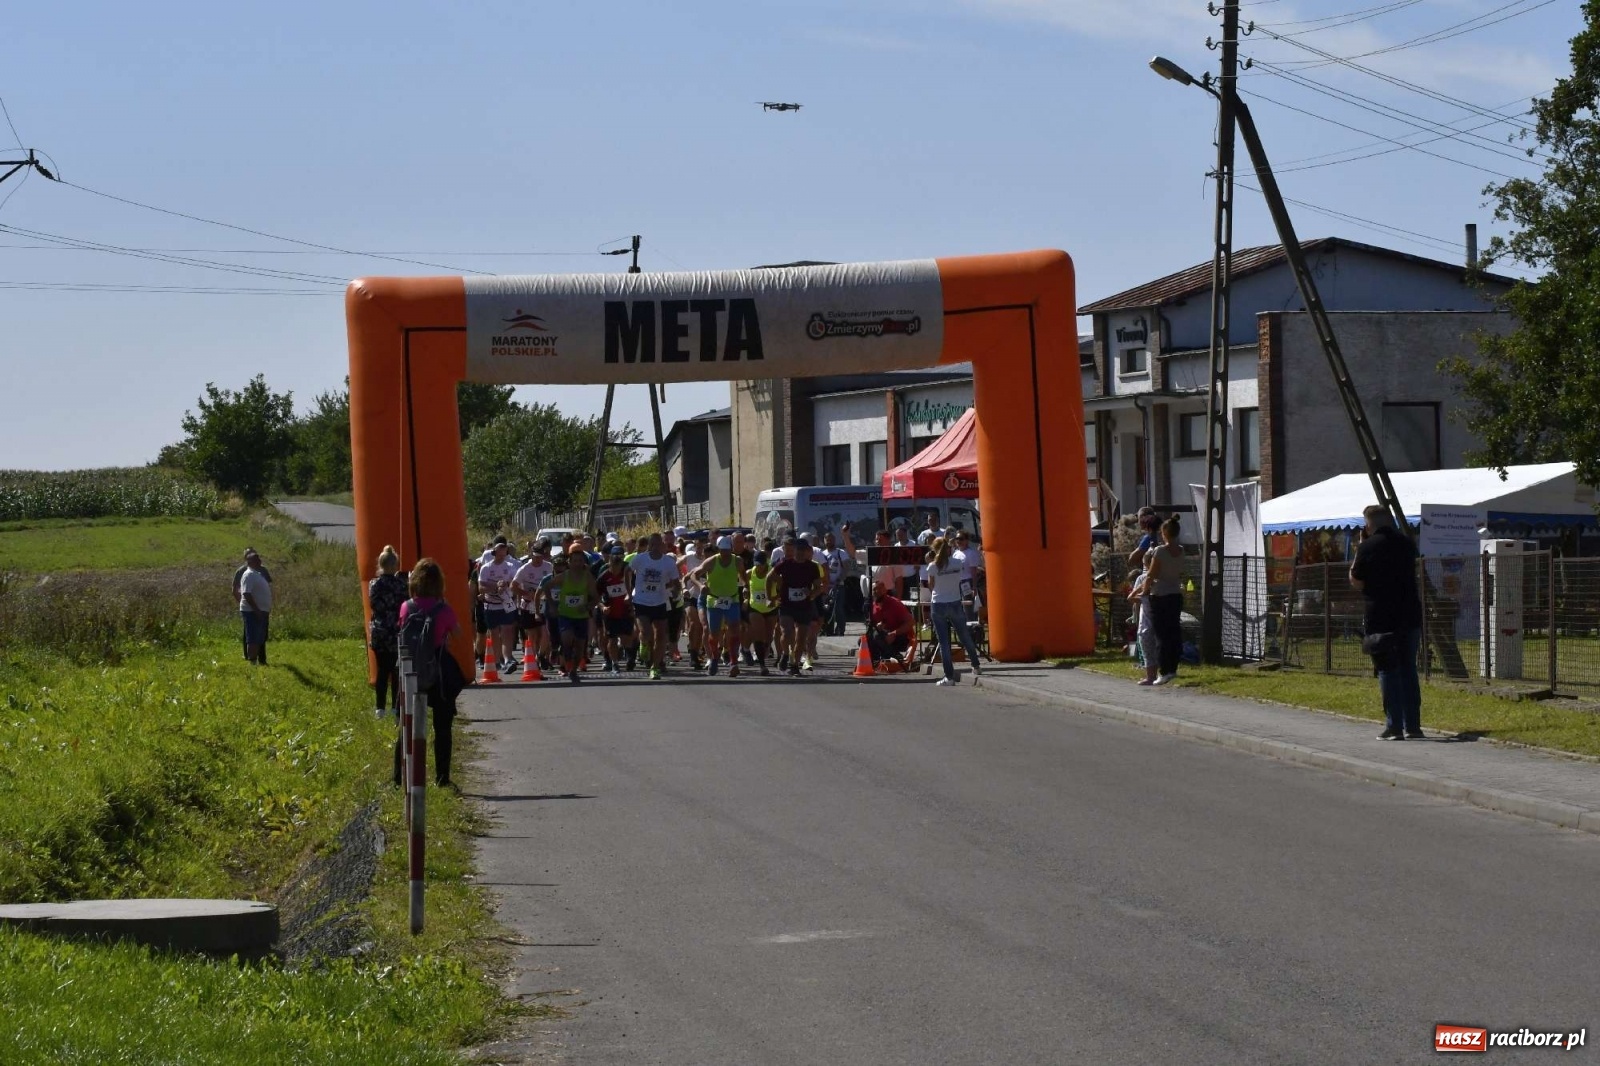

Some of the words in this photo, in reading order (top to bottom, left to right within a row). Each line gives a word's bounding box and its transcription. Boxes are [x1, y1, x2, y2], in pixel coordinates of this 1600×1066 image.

[604, 298, 764, 364] META
[492, 336, 558, 346] MARATONY
[491, 347, 558, 356] POLSKIE.PL
